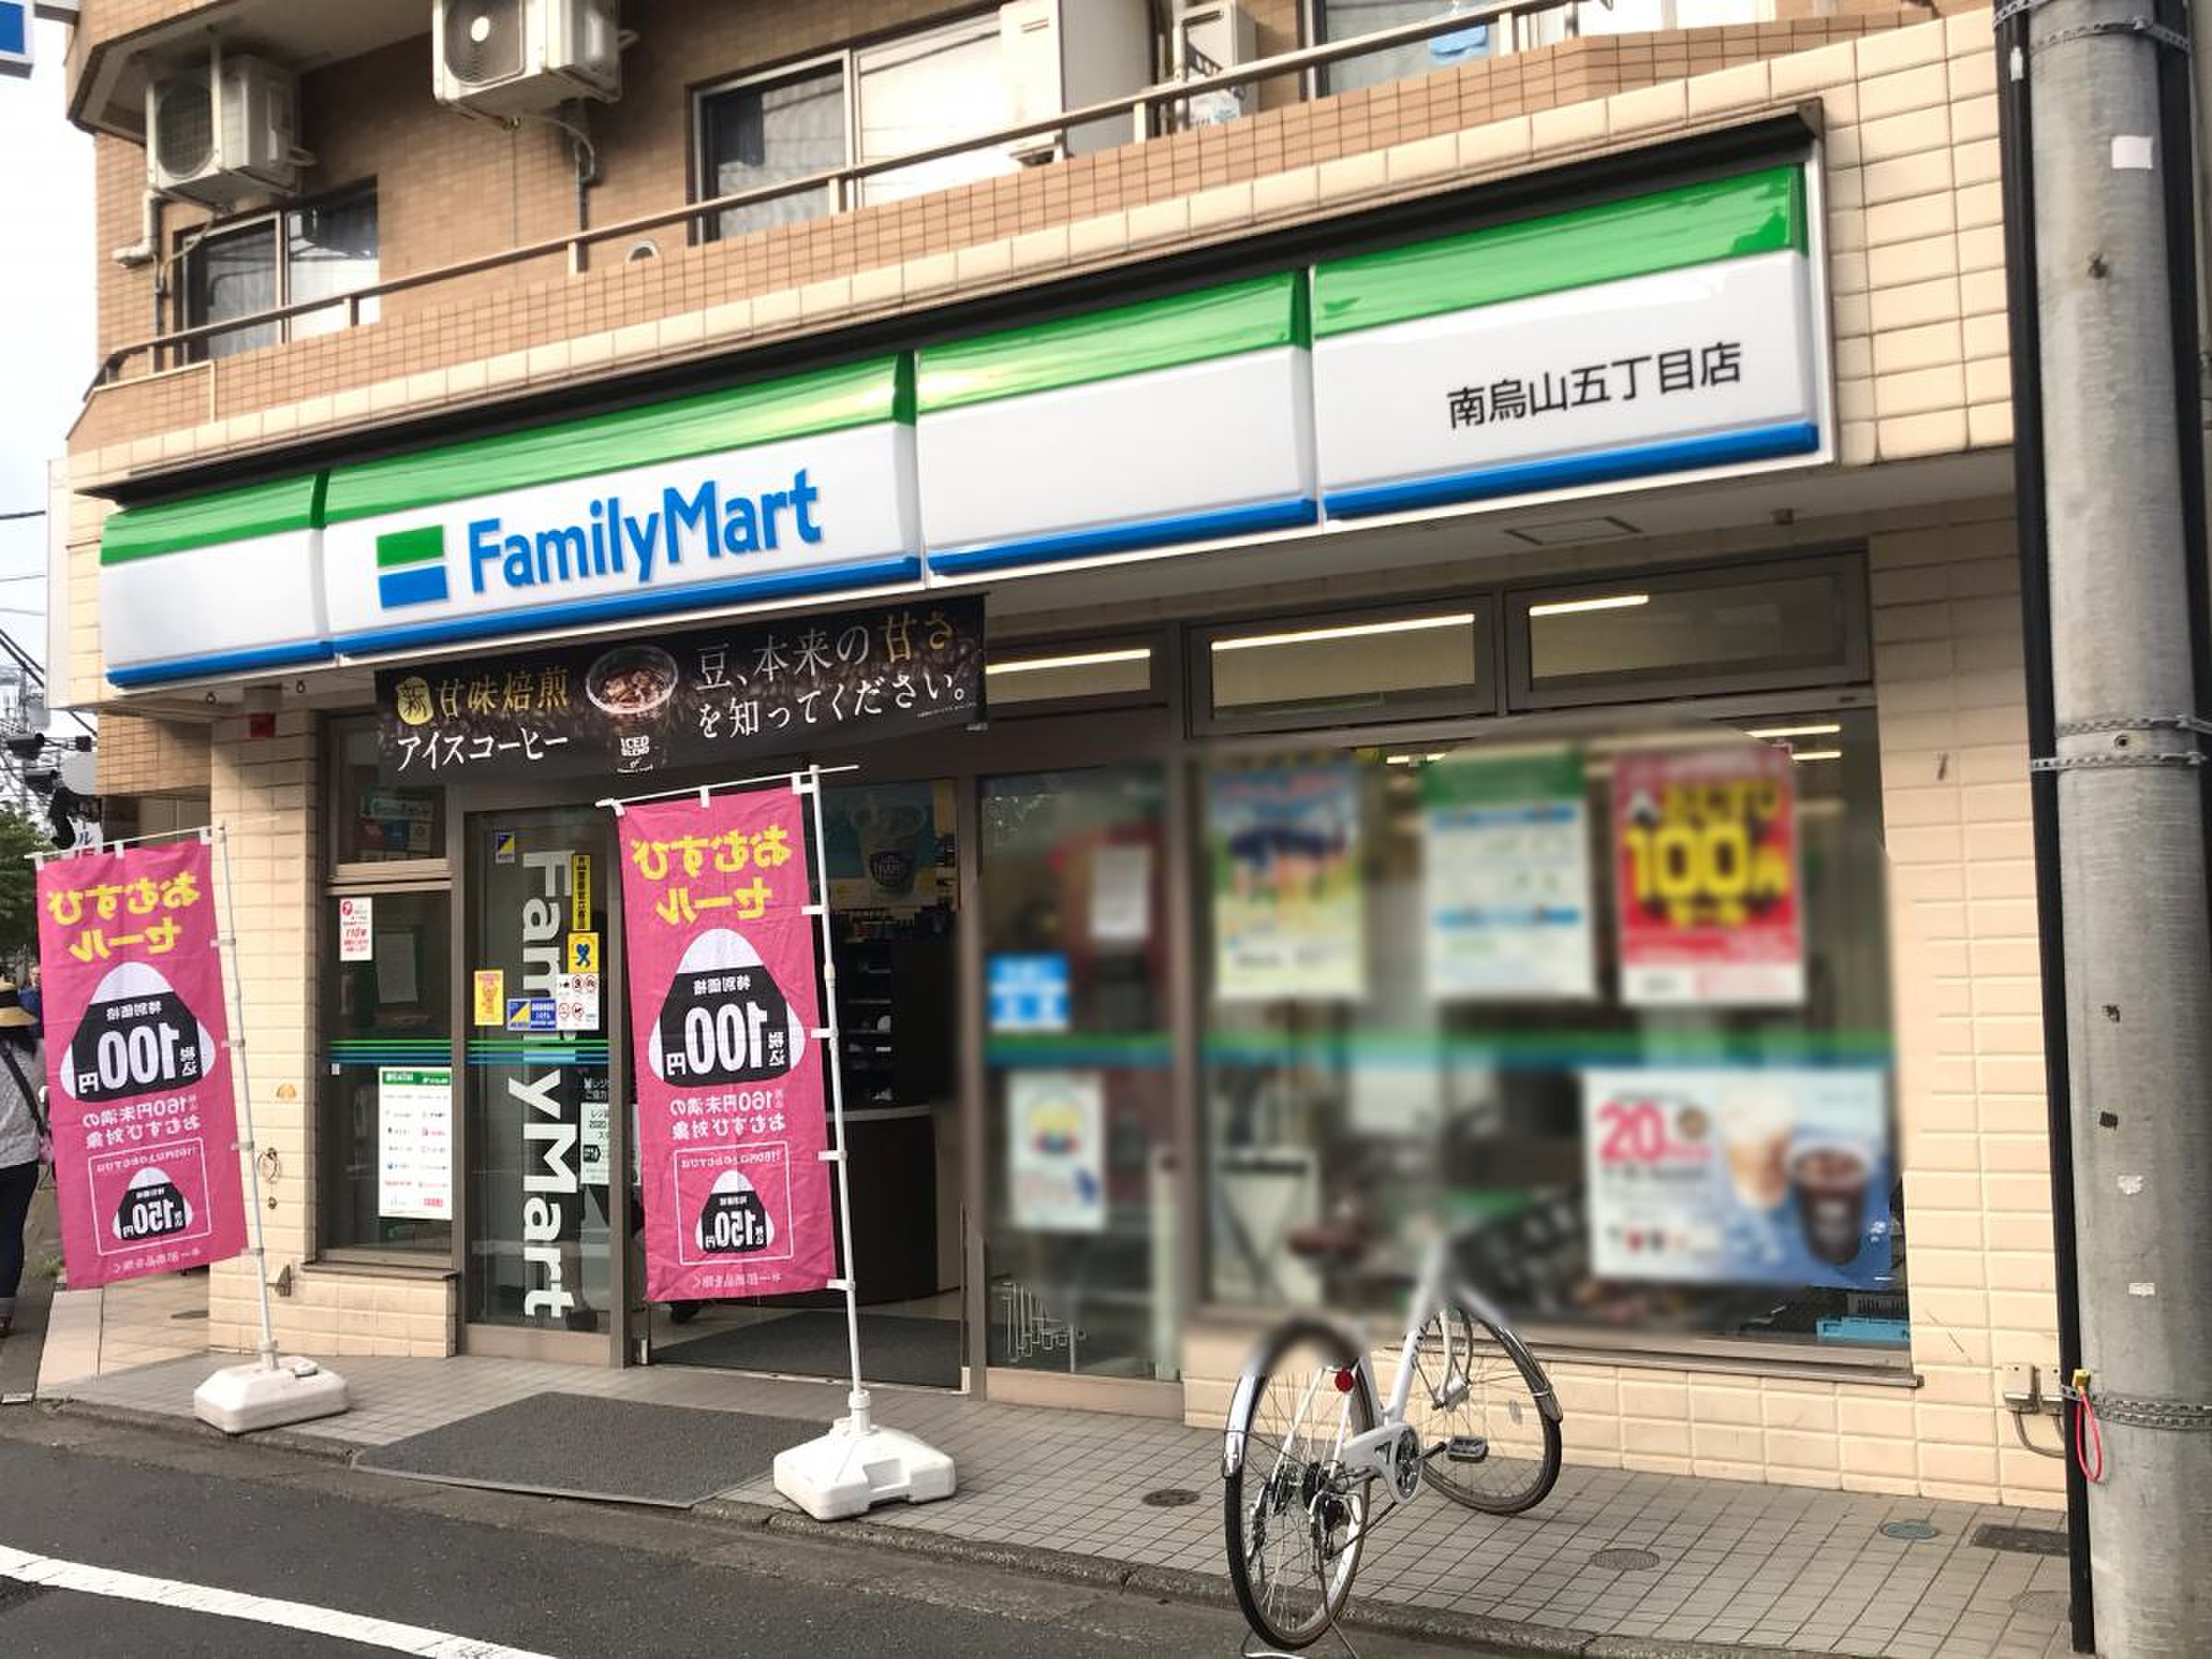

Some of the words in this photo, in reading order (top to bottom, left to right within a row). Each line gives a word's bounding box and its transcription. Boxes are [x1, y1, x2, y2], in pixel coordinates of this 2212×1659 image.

[1447, 342, 1741, 429] 南烏山五丁目店
[468, 468, 823, 594] FamilyMart
[696, 611, 953, 691] 豆、本来の甘さ
[438, 665, 571, 719] 甘味焙煎
[699, 672, 964, 738] を知ってください。
[397, 727, 568, 771] アイスコーヒー
